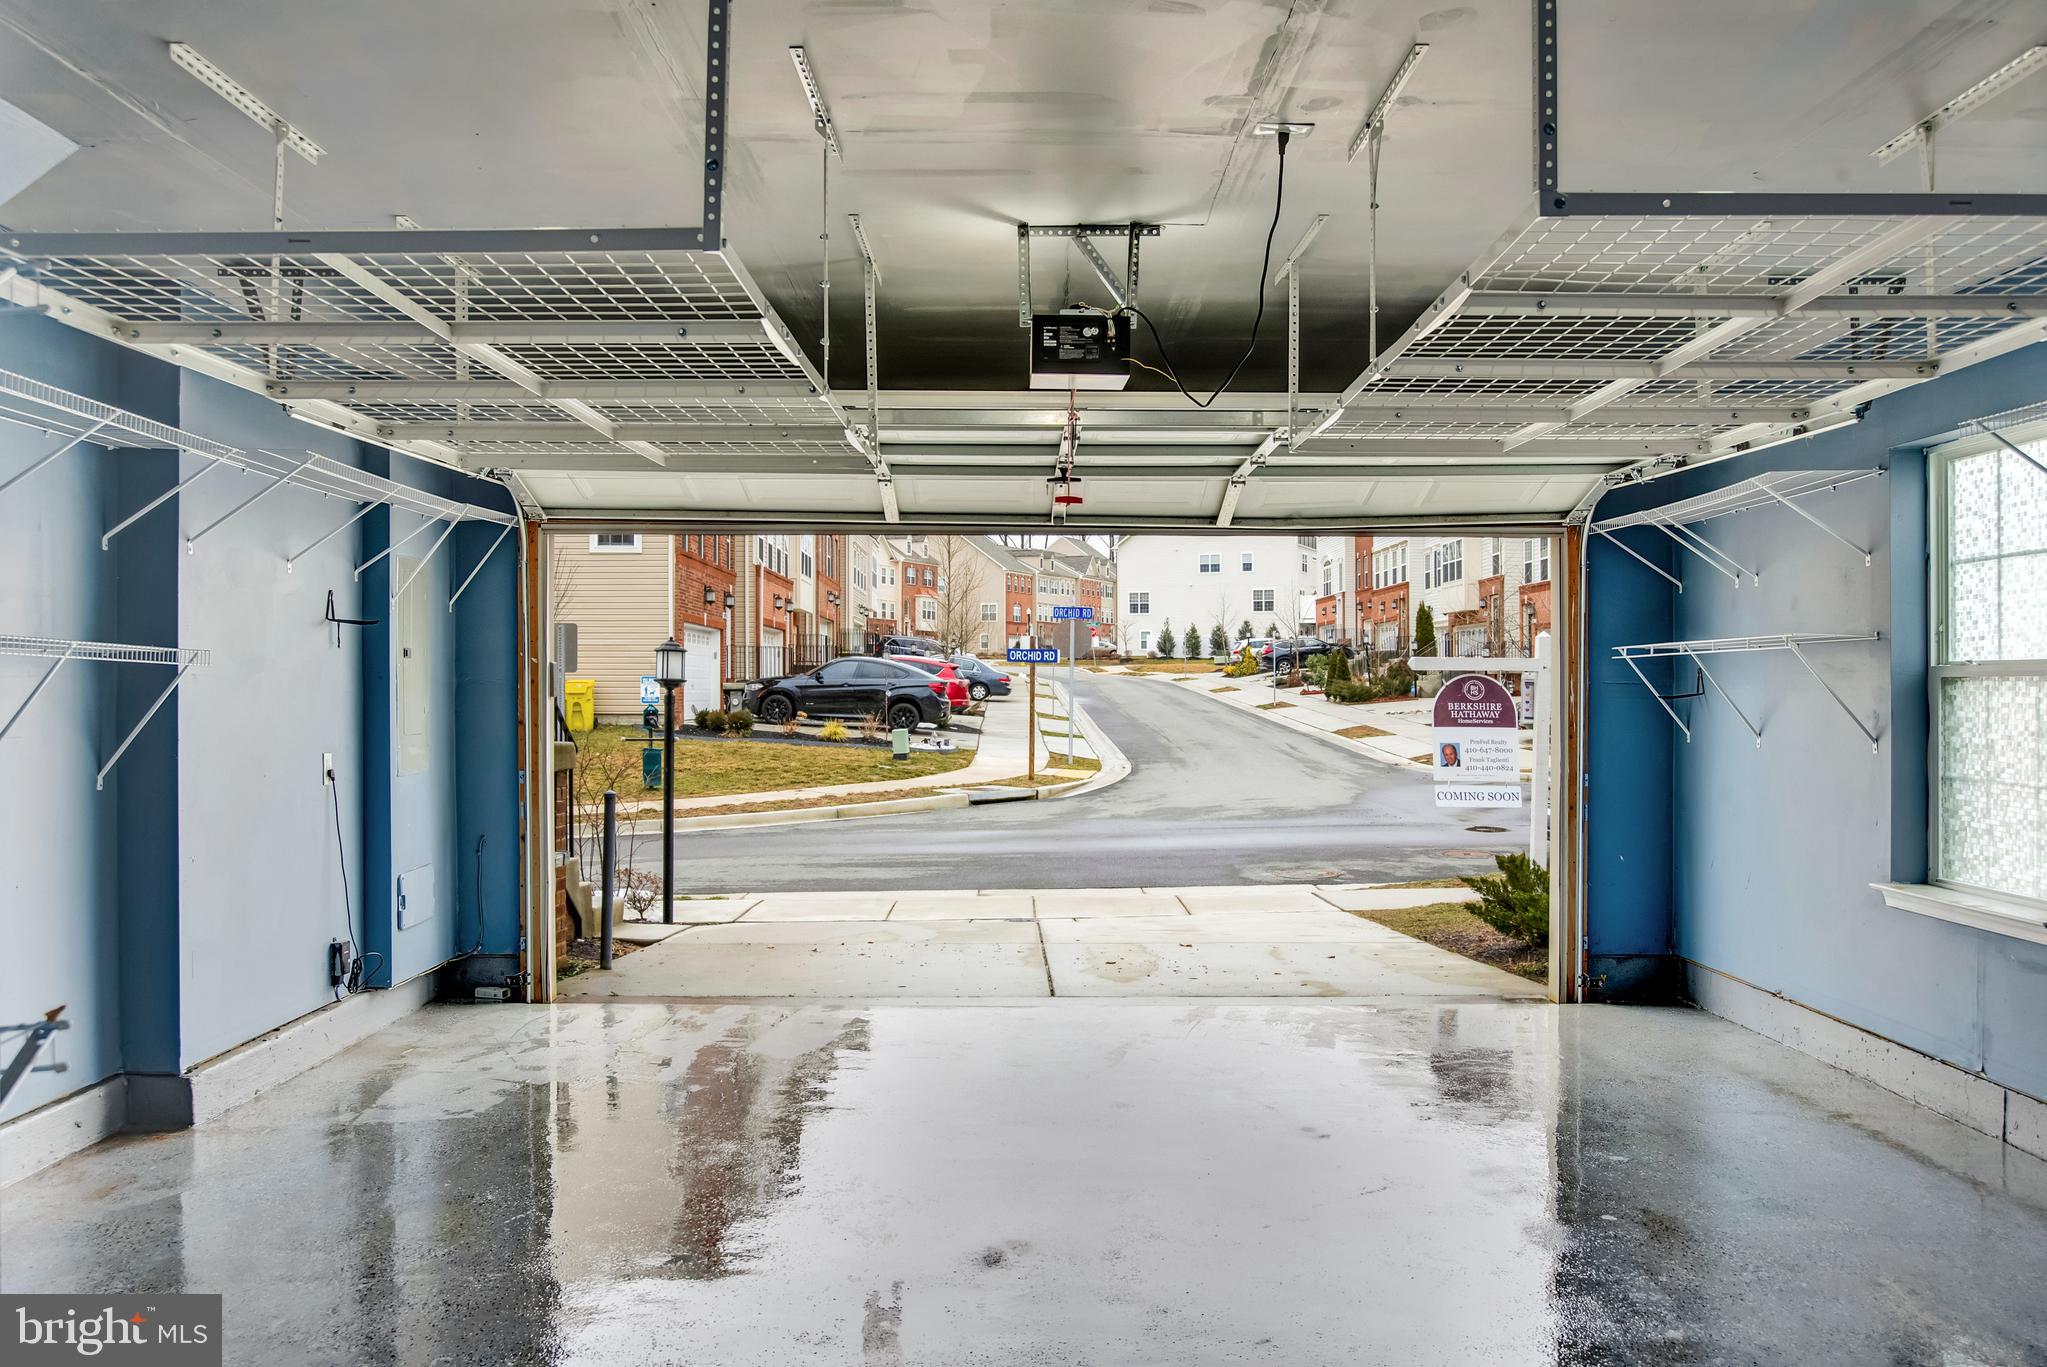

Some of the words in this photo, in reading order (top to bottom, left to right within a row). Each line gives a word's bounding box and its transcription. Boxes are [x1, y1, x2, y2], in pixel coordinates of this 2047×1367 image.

[1054, 608, 1080, 617] ORCHID
[1083, 608, 1092, 617] RD
[1009, 650, 1041, 661] ORCHID
[1043, 651, 1055, 661] RD
[1448, 702, 1502, 710] BERKSHIRE
[1450, 710, 1500, 718] HATHAWAY
[1465, 764, 1514, 772] 410-440-0824
[1436, 791, 1485, 801] COMING
[1487, 791, 1520, 801] SOON
